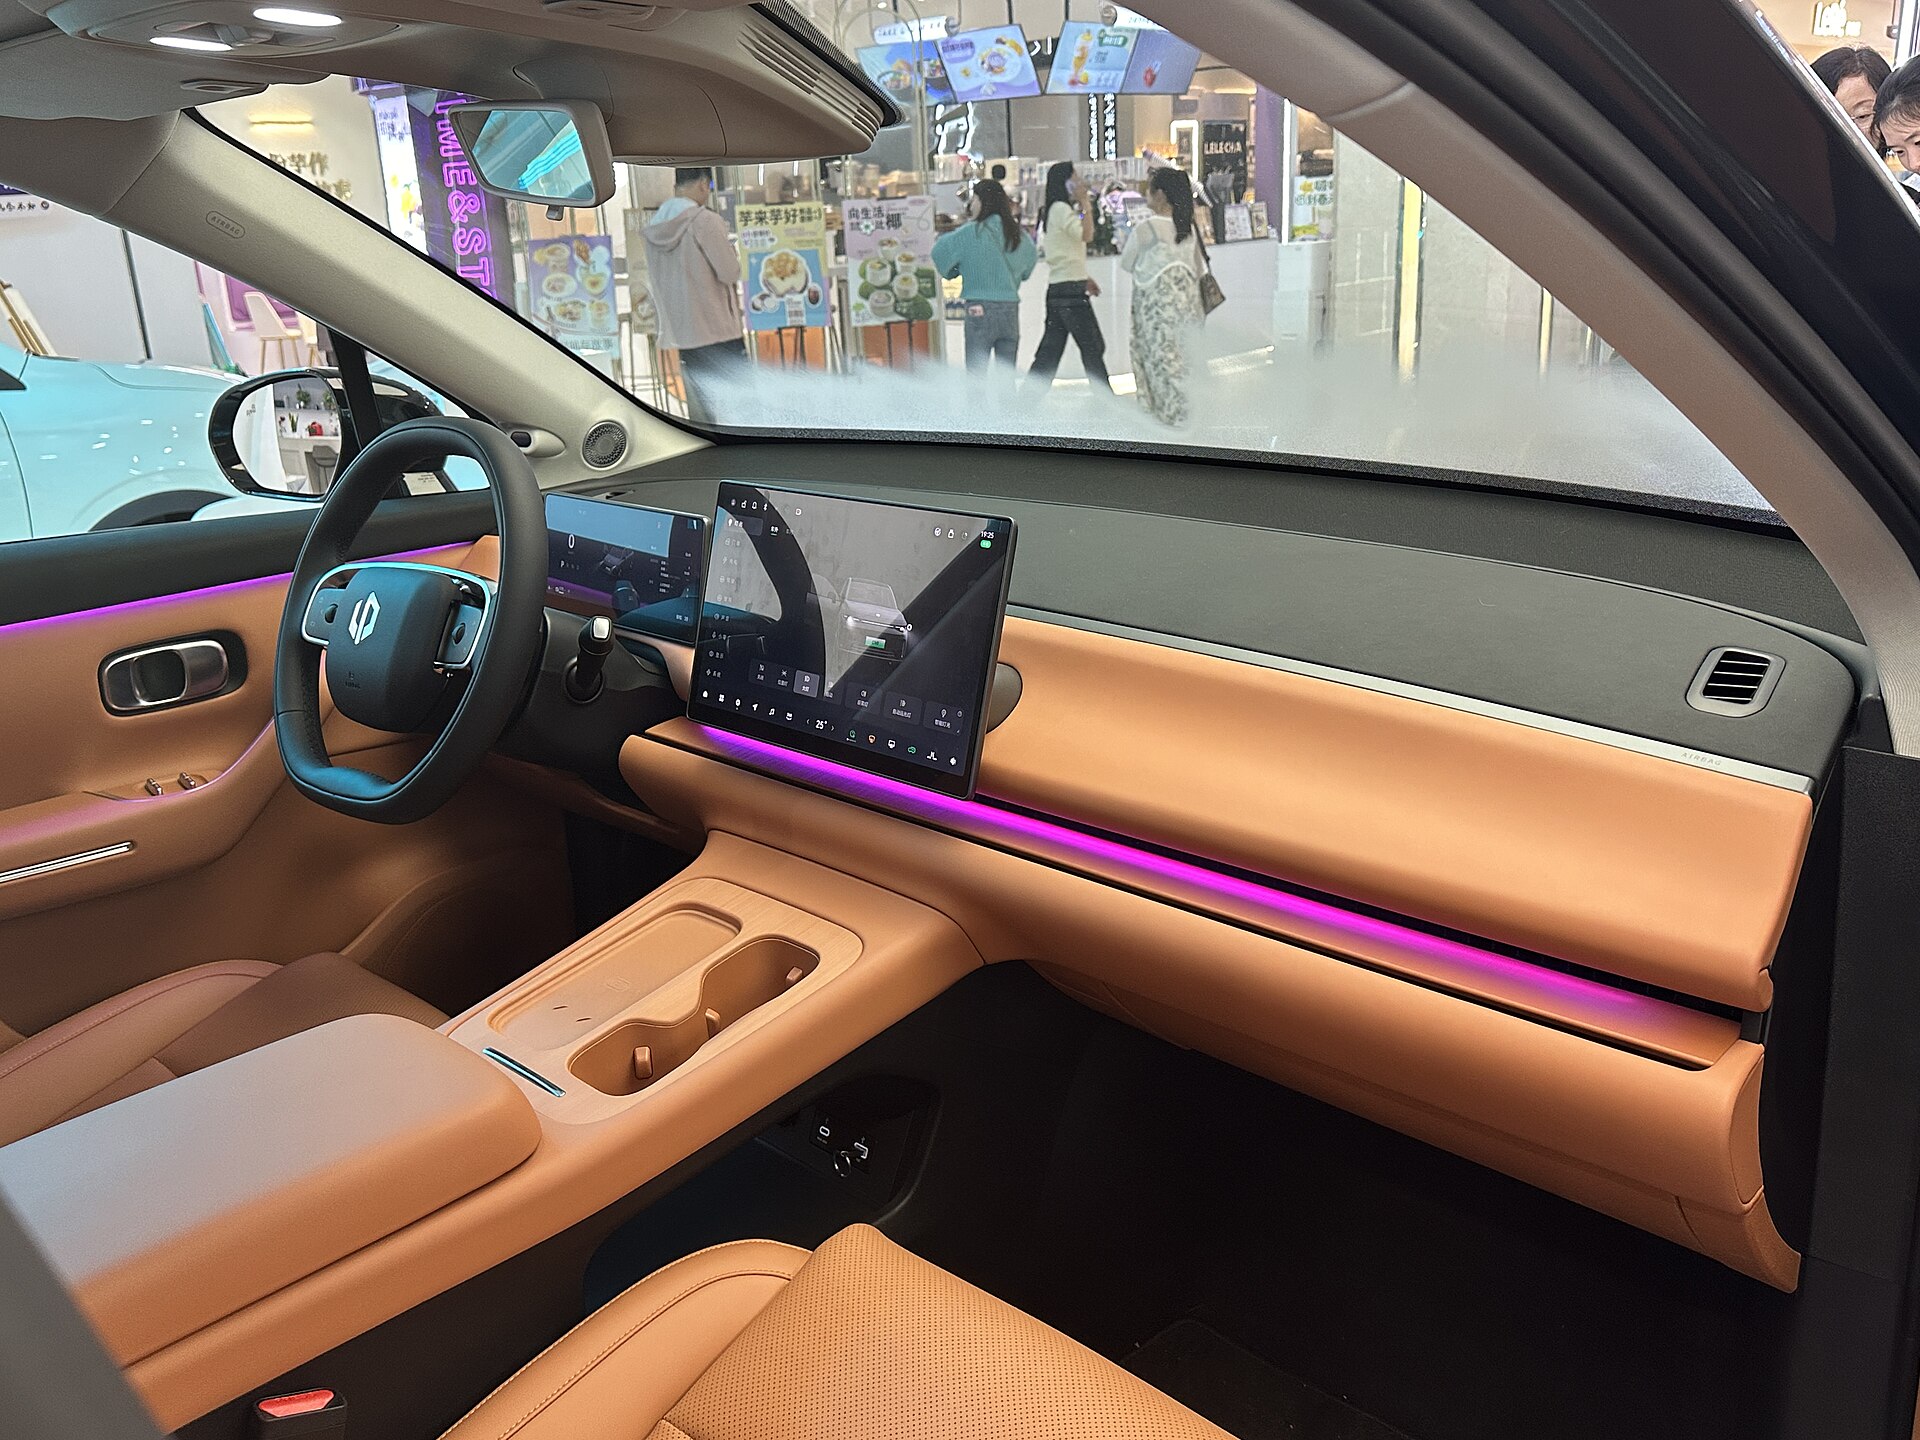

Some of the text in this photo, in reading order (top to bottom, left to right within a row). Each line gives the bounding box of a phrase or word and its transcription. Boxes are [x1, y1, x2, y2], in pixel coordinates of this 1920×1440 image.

[210, 215, 241, 235] AIRBAG
[568, 533, 575, 549] 0
[1680, 752, 1721, 766] AIRBAG
